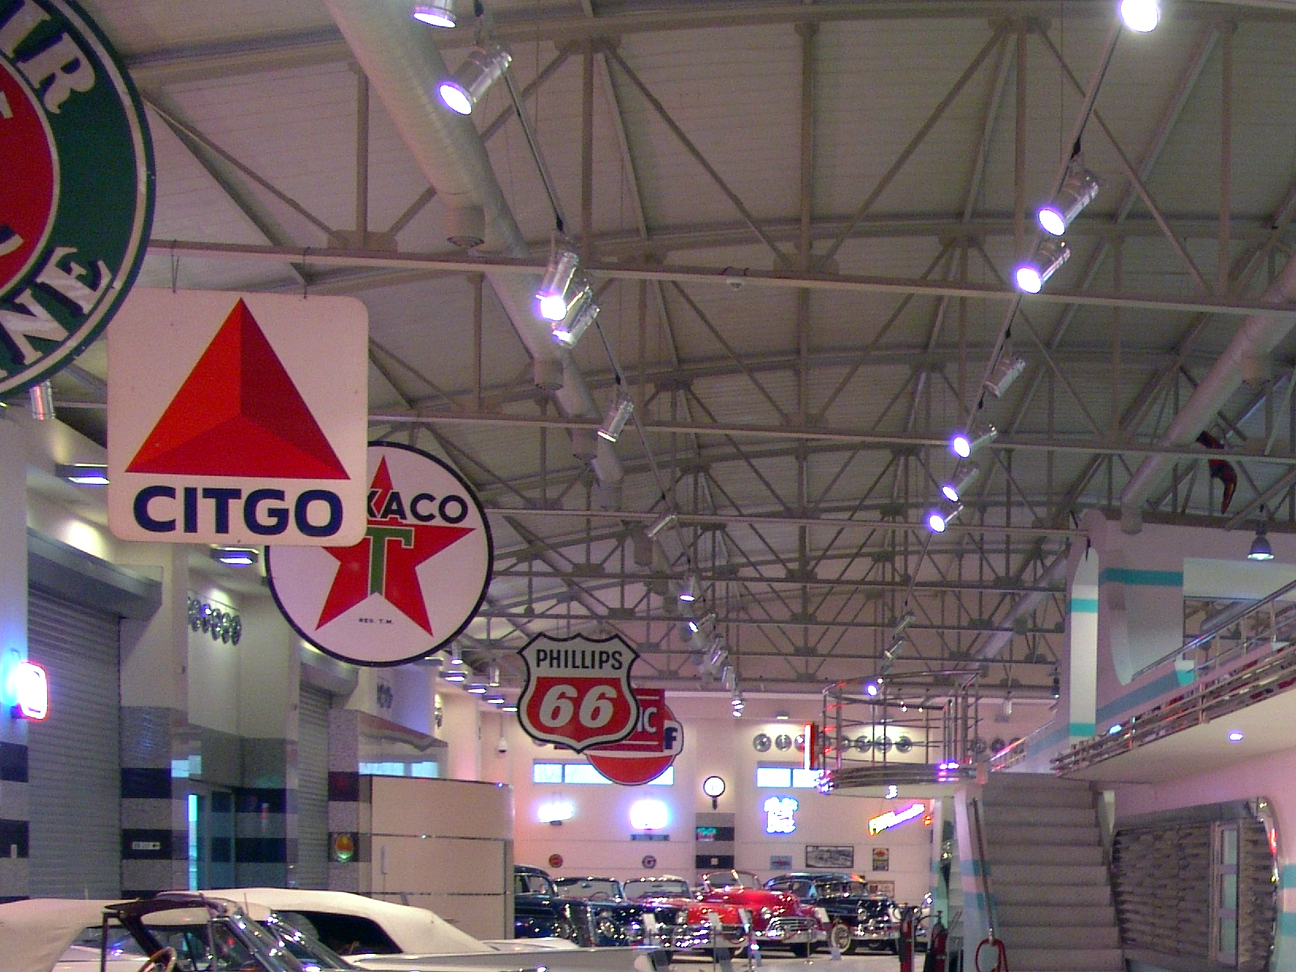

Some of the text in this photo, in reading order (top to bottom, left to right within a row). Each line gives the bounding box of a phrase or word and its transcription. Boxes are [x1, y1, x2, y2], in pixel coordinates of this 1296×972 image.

[133, 485, 344, 537] CITGO
[536, 648, 623, 671] PHILLIPS
[538, 684, 618, 729] 66
